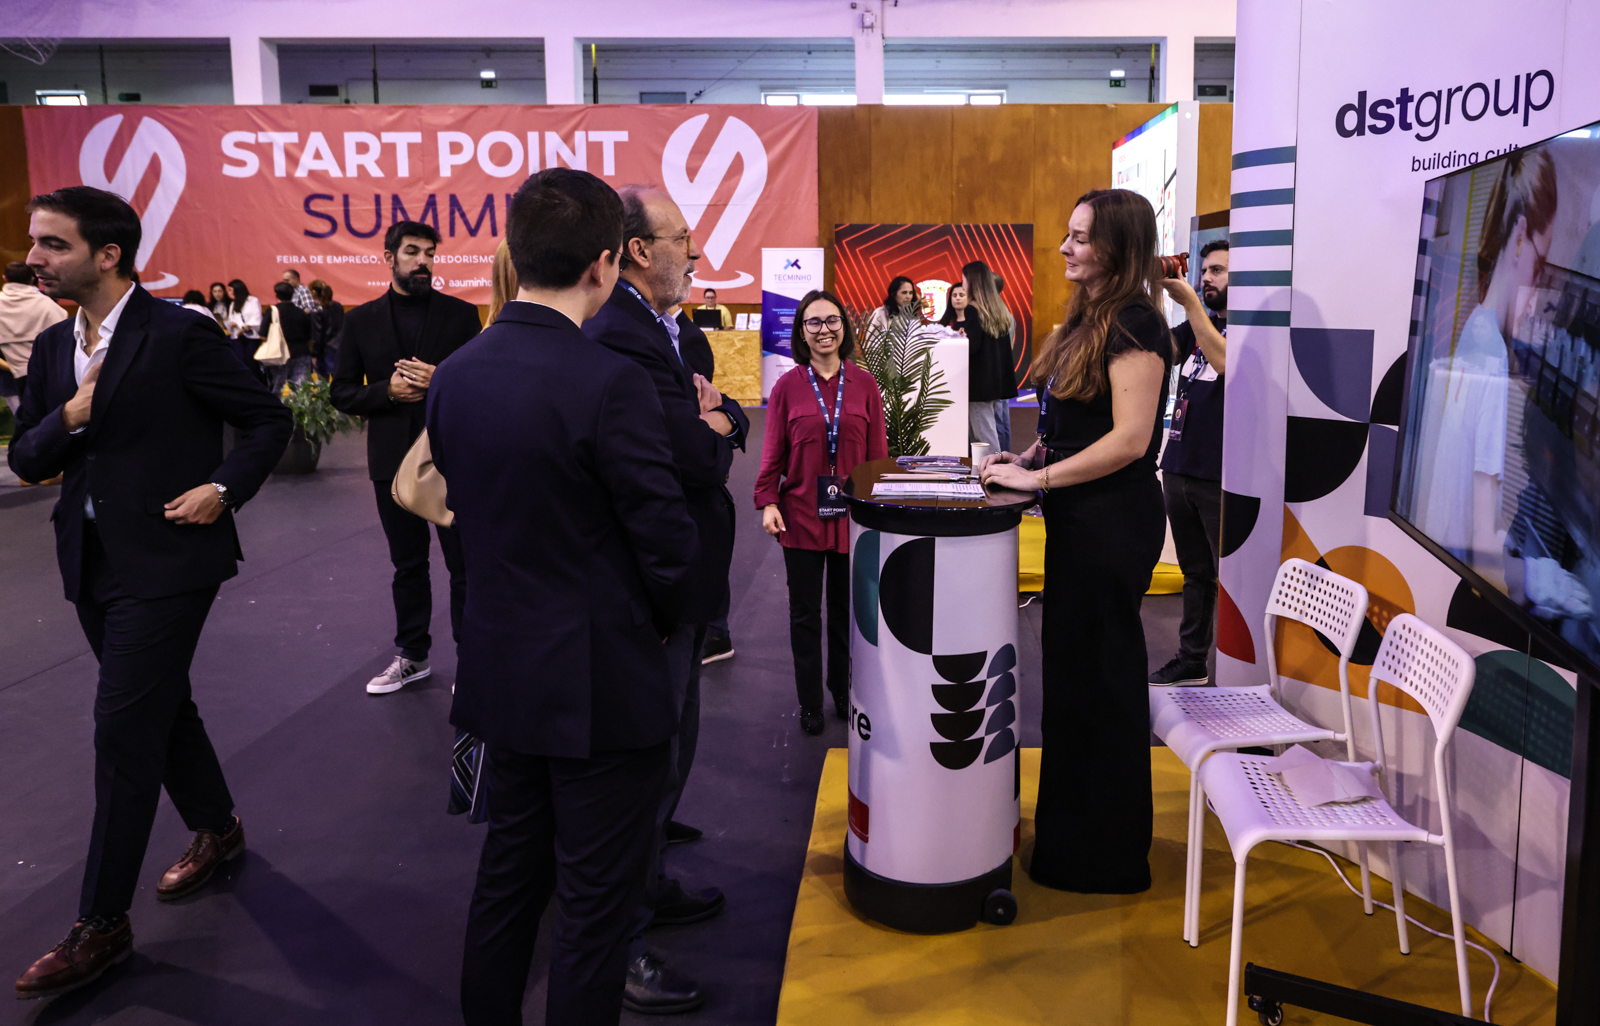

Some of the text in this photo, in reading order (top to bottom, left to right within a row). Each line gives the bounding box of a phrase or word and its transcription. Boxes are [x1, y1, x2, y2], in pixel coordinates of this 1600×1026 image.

[1335, 69, 1555, 142] dstgroup
[221, 130, 629, 178] START POINT
[1411, 150, 1479, 172] building
[276, 255, 495, 265] FEIRA DE EMPREGO, DEDORISMO
